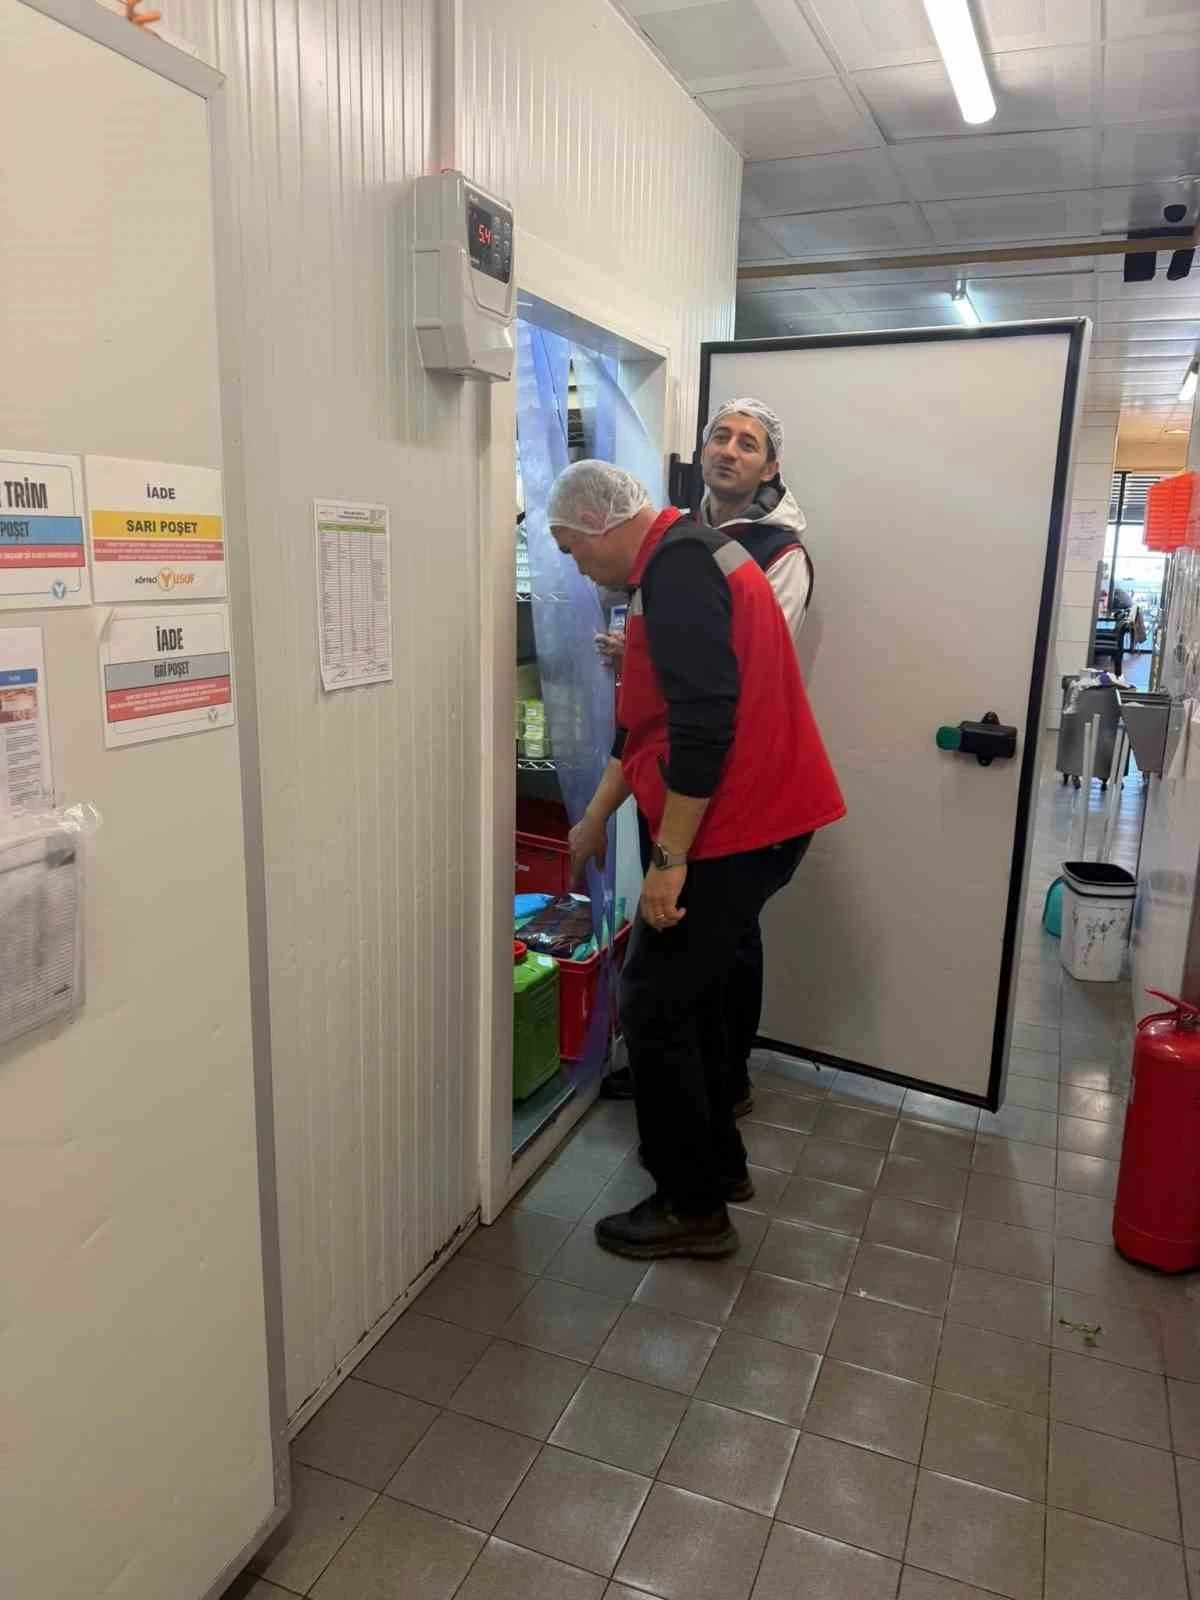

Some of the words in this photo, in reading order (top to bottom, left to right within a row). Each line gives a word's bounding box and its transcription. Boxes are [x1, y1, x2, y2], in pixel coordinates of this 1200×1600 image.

[4, 477, 48, 509] TRİM
[146, 482, 176, 500] İADE
[0, 521, 31, 543] POŞET
[126, 519, 156, 533] SARI
[160, 521, 198, 536] POŞET
[156, 625, 184, 652] İADE
[167, 661, 189, 678] POŞET
